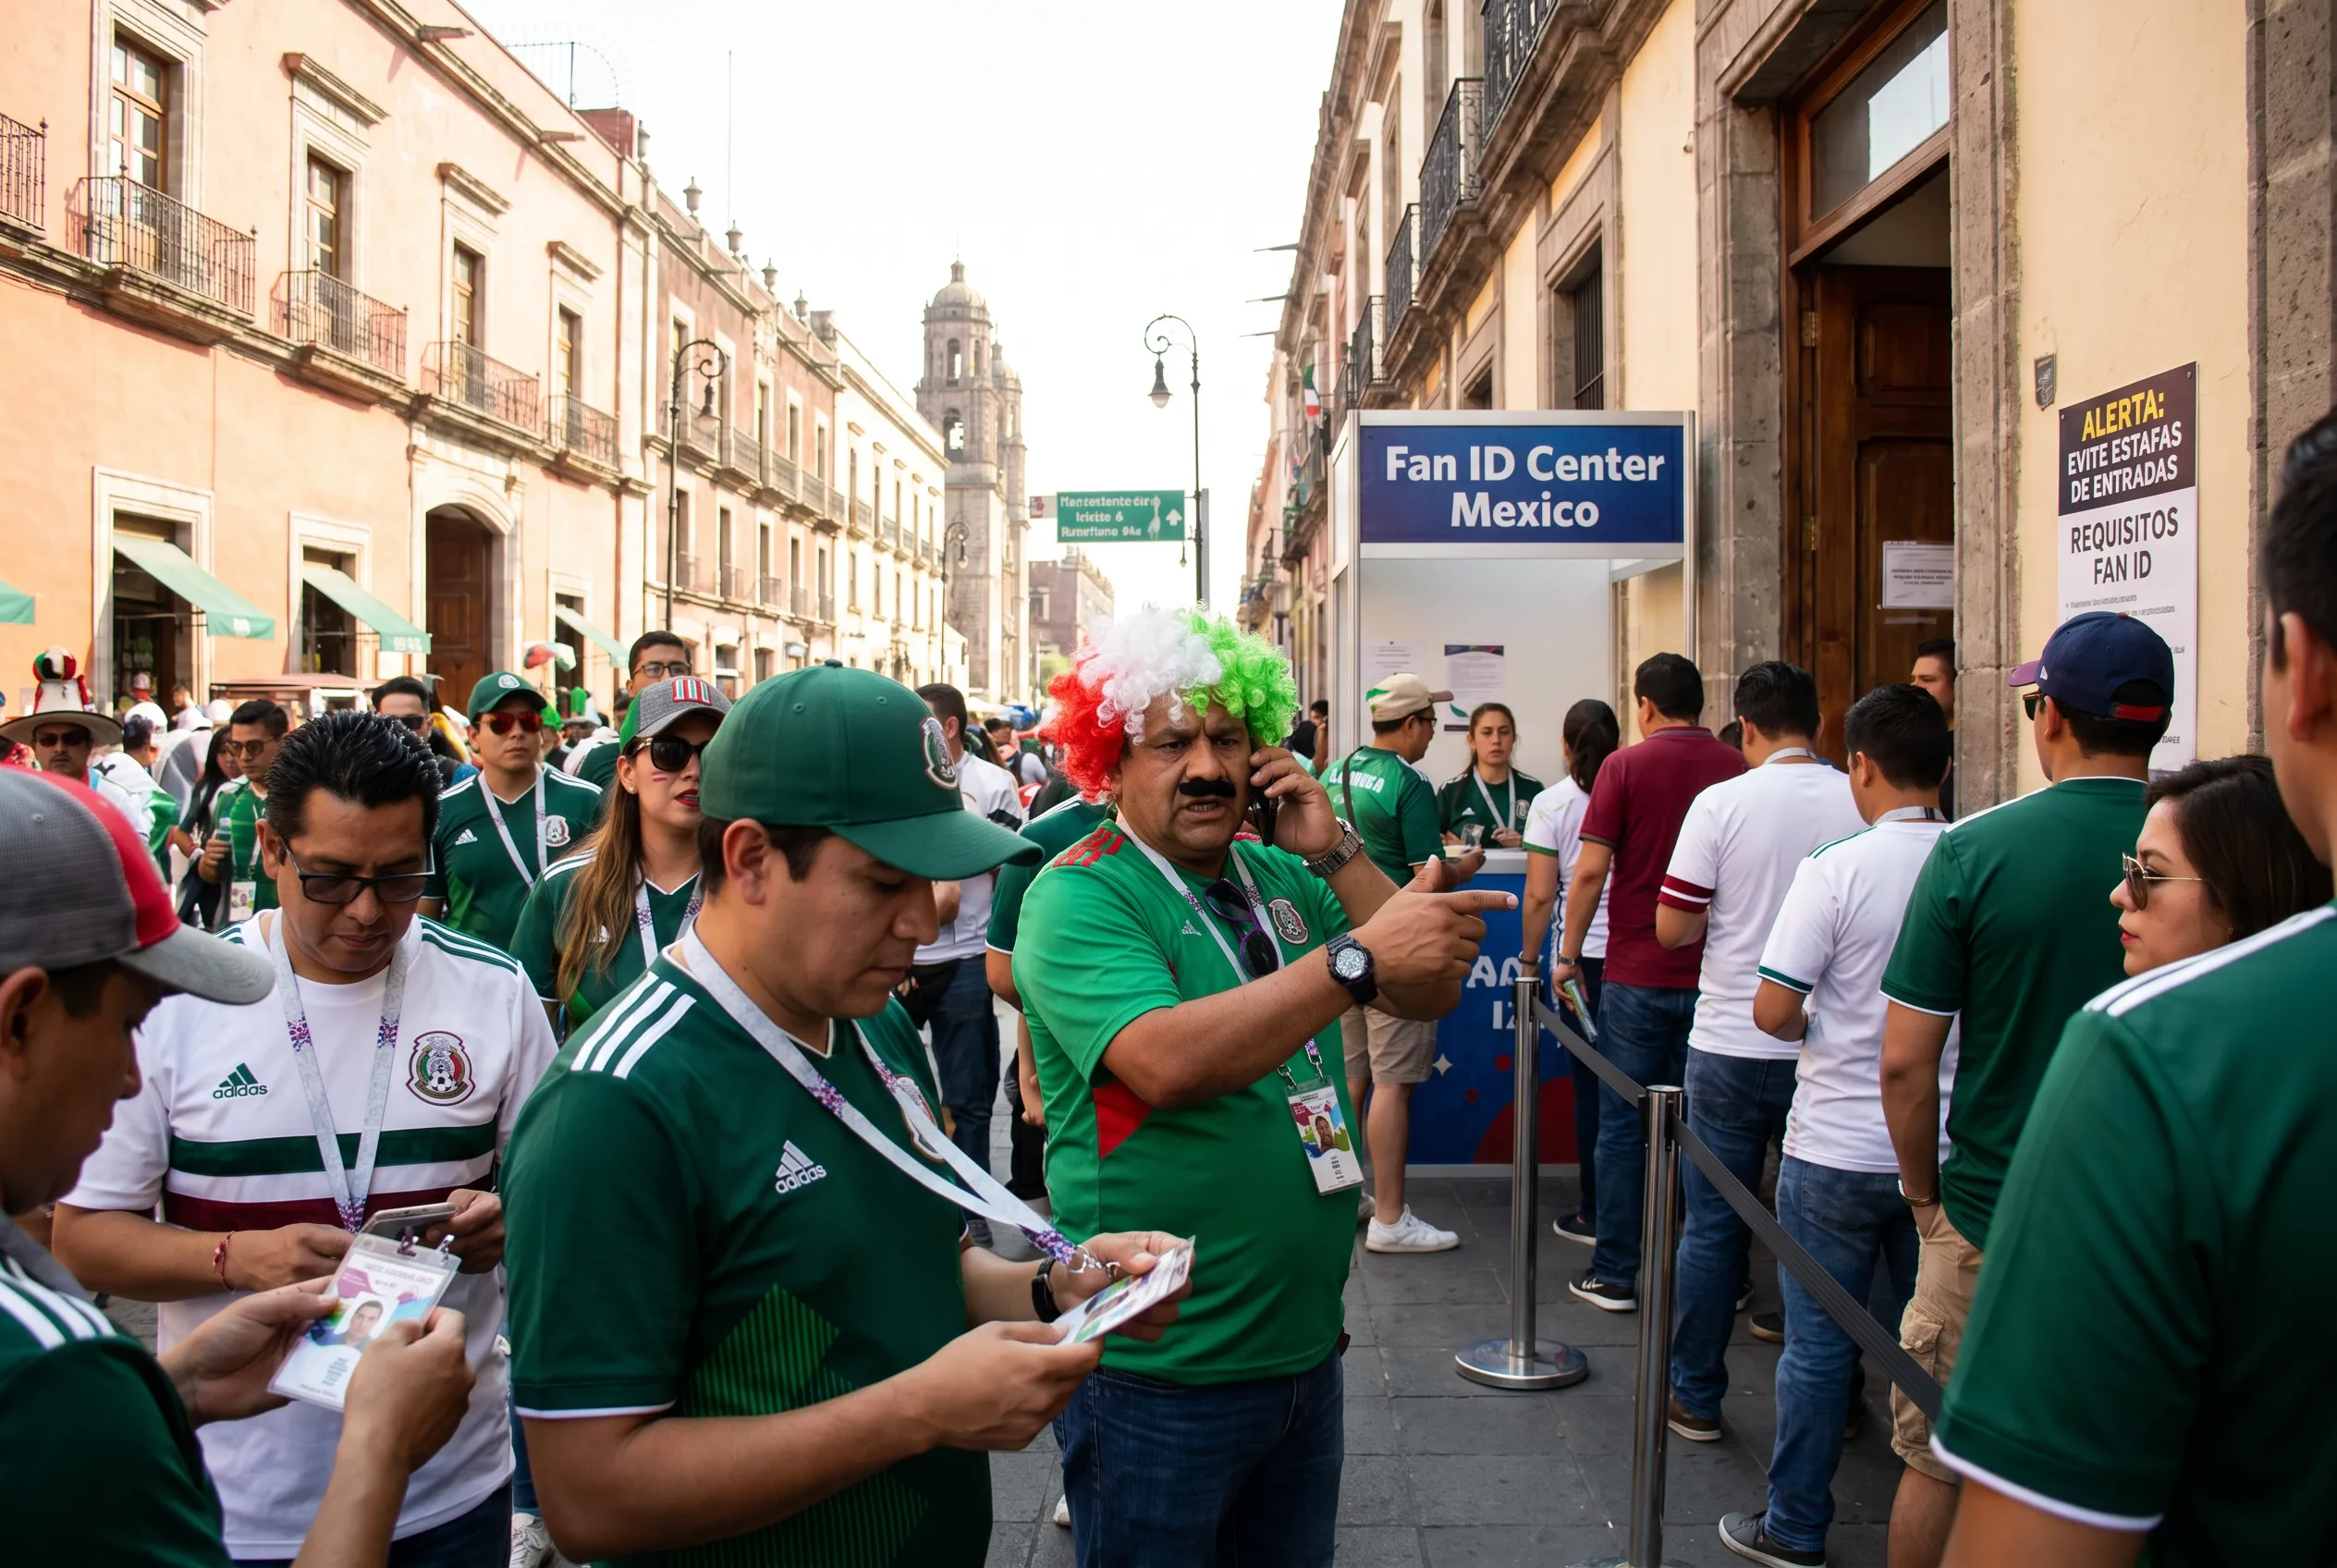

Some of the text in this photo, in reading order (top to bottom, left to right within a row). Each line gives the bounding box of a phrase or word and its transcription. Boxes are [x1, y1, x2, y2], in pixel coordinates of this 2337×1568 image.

[2081, 388, 2164, 442] ALERTA:
[1387, 445, 1665, 481] Fan ID Center
[2068, 421, 2182, 475] EVITE ESTAFAS
[2071, 454, 2178, 504] DE ENTRADAS
[1450, 491, 1599, 528] Mexico
[2071, 507, 2179, 554] REQUISITOS
[2094, 550, 2152, 585] FAN ID
[213, 1084, 268, 1099] adidas
[775, 1165, 827, 1194] adidas
